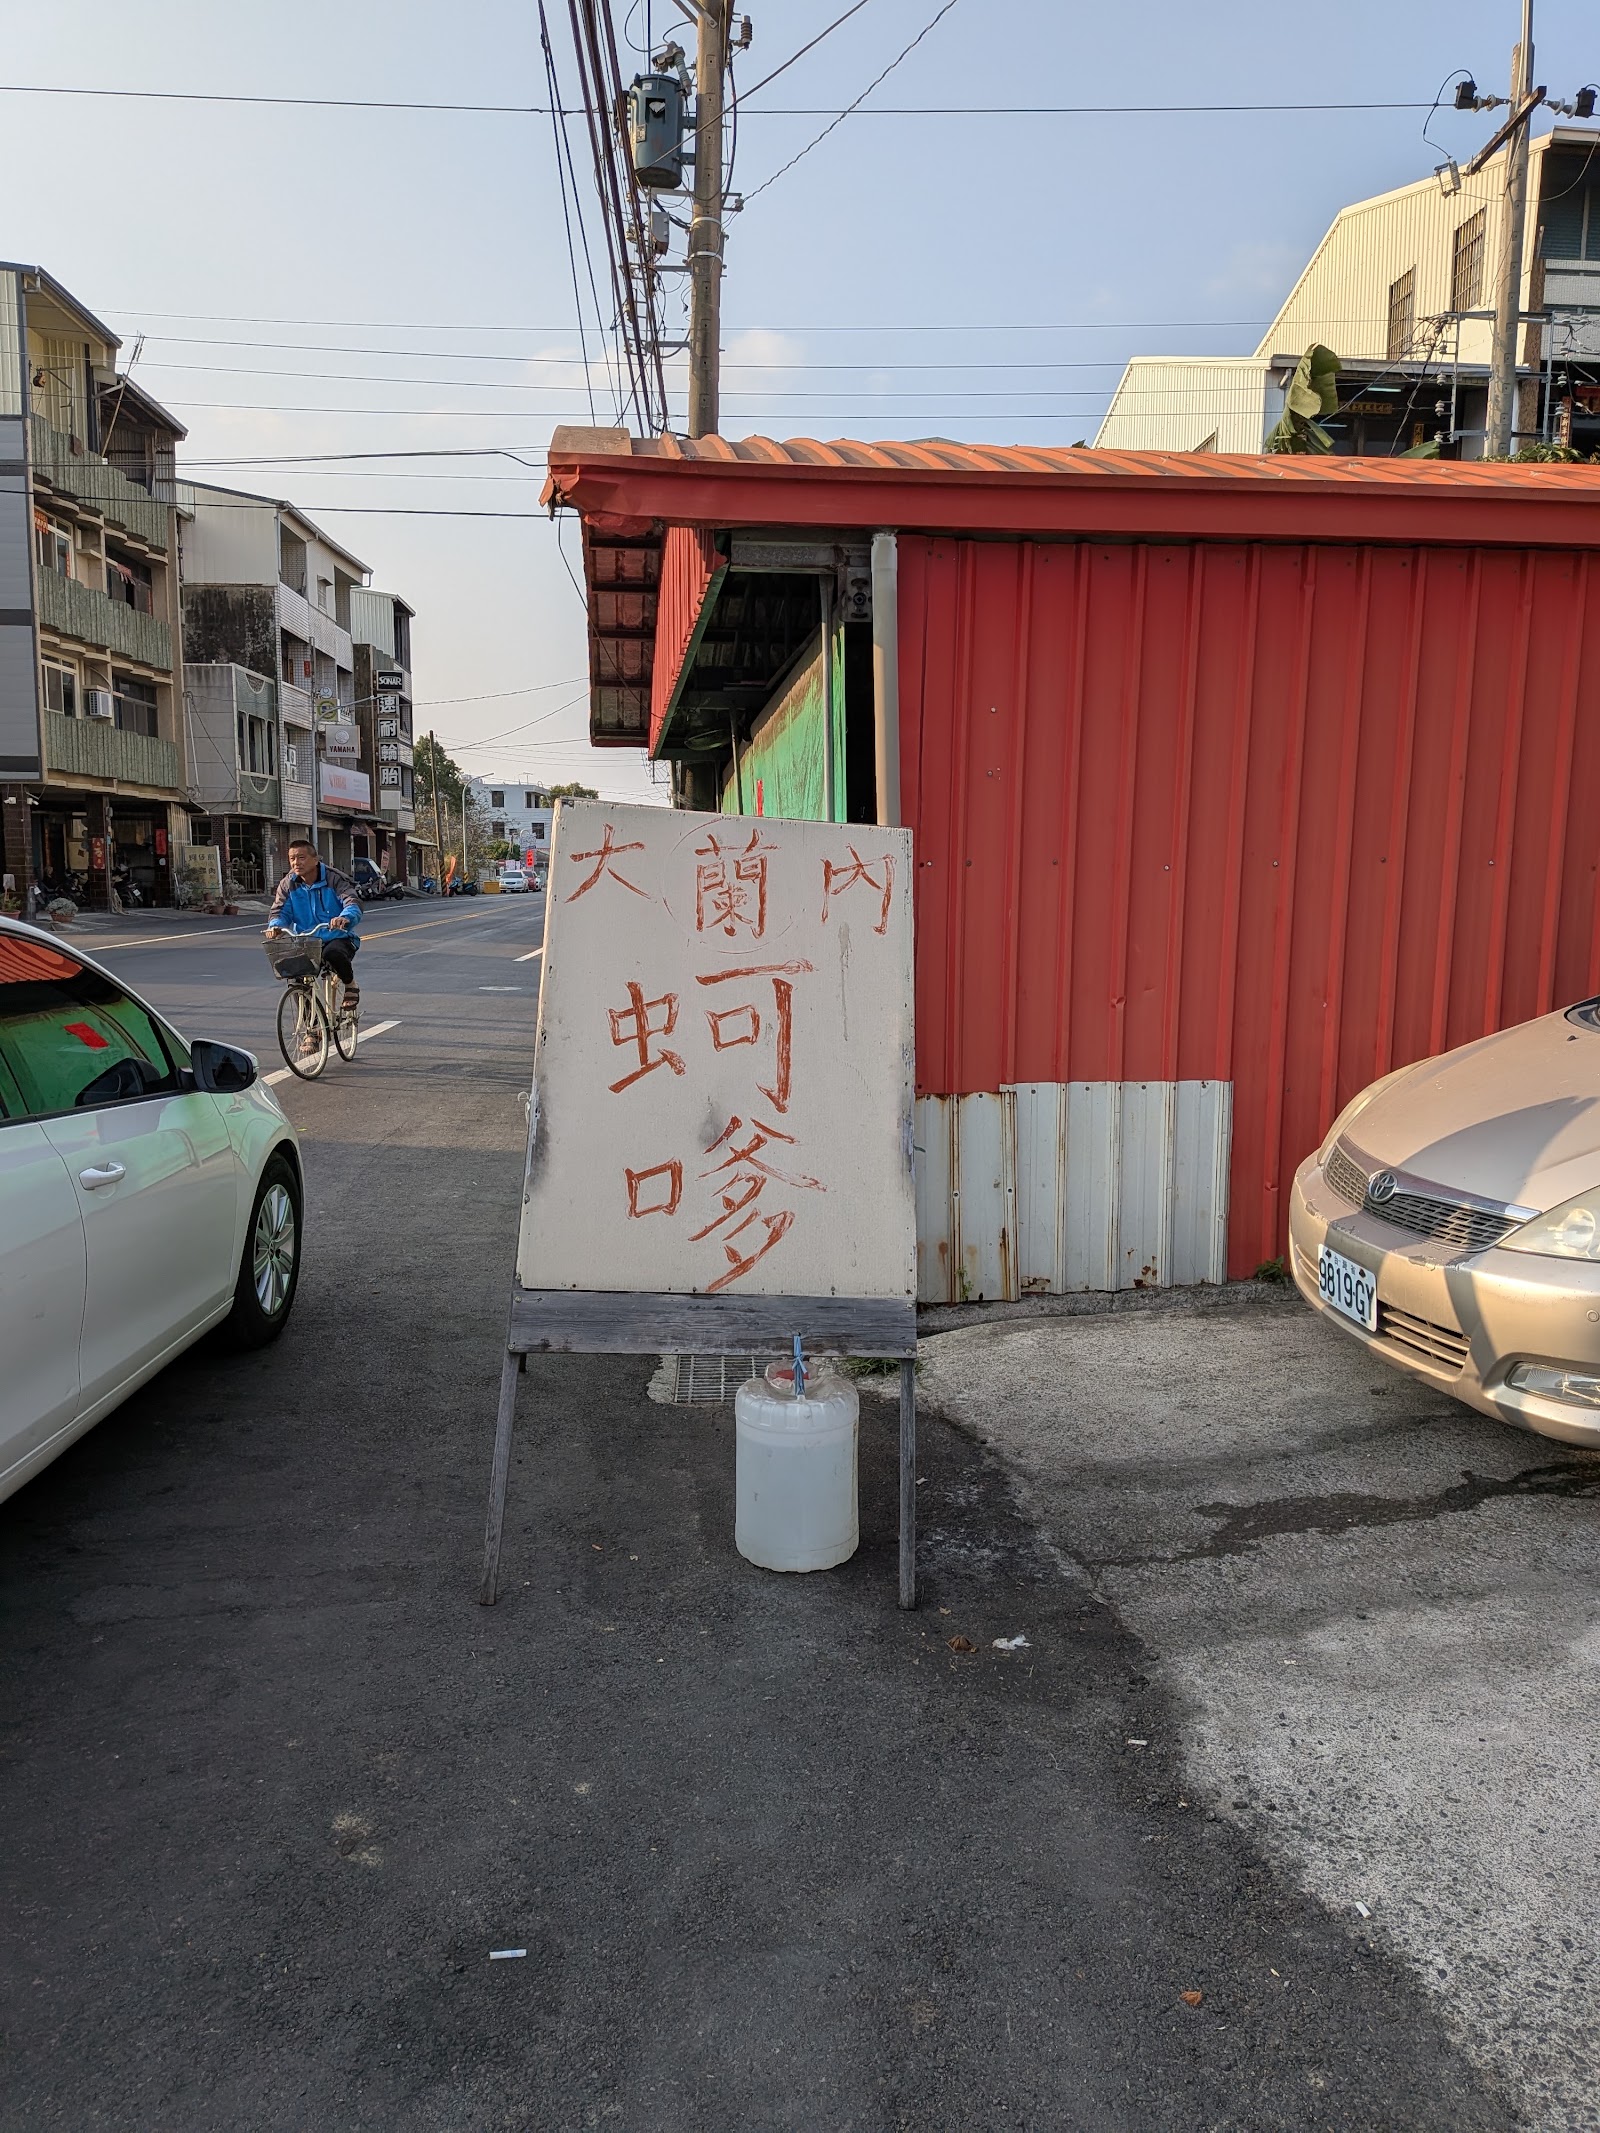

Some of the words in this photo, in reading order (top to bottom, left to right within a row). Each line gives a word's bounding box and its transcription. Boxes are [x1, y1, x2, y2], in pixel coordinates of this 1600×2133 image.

[378, 675, 402, 685] SONAR
[329, 745, 356, 754] YAMAHA
[380, 695, 399, 785] 速耐輪胎
[1319, 1258, 1374, 1320] 9819-GY
